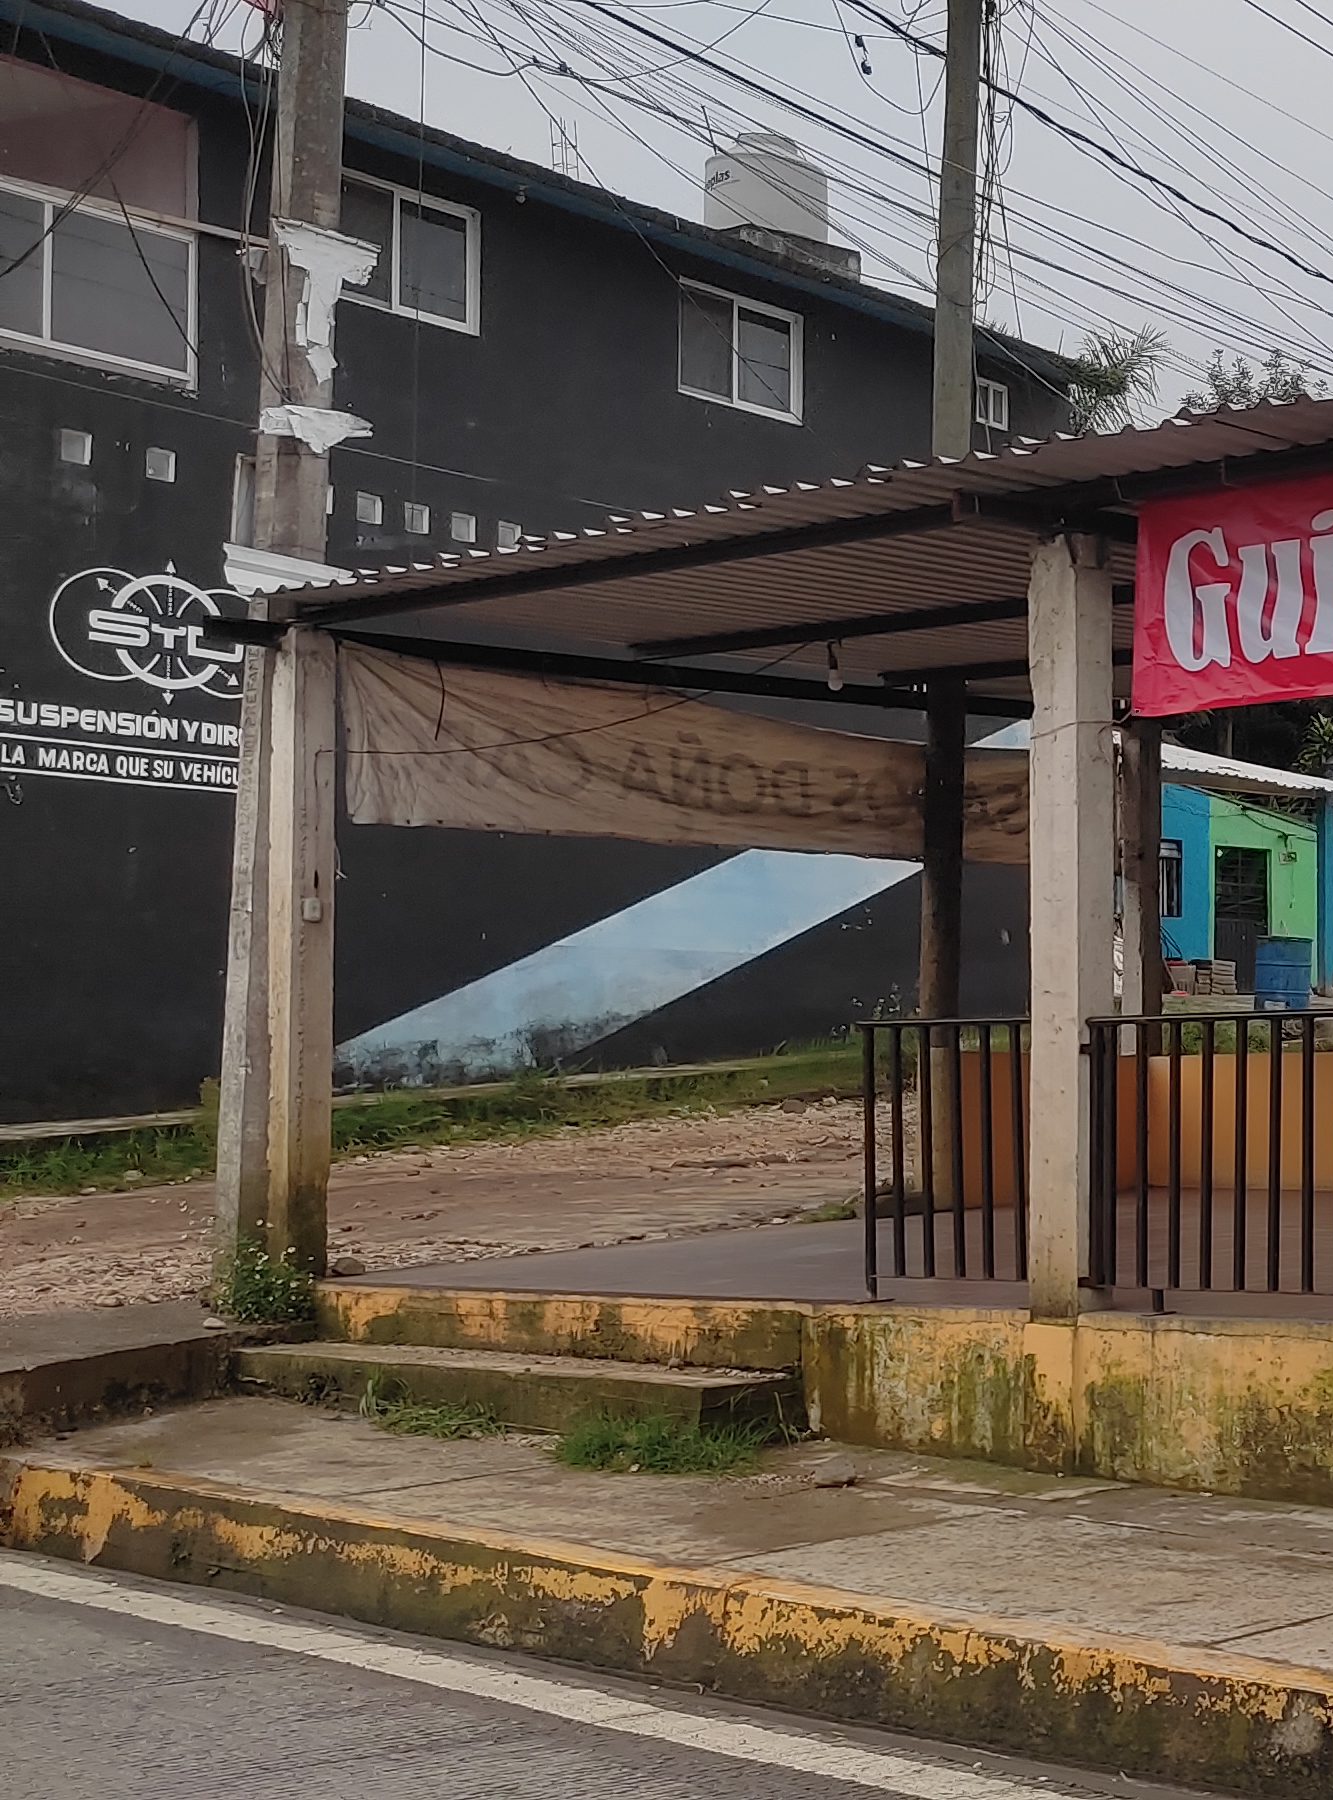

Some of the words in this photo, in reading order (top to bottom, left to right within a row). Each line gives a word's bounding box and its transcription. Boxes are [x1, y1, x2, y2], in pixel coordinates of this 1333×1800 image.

[0, 698, 178, 740] SUSPENSIÓN
[181, 718, 200, 742] Y
[202, 722, 243, 747] DIR
[2, 743, 26, 764] LA
[39, 747, 110, 774] MARCA
[116, 755, 149, 777] QUE
[152, 760, 175, 779] SU
